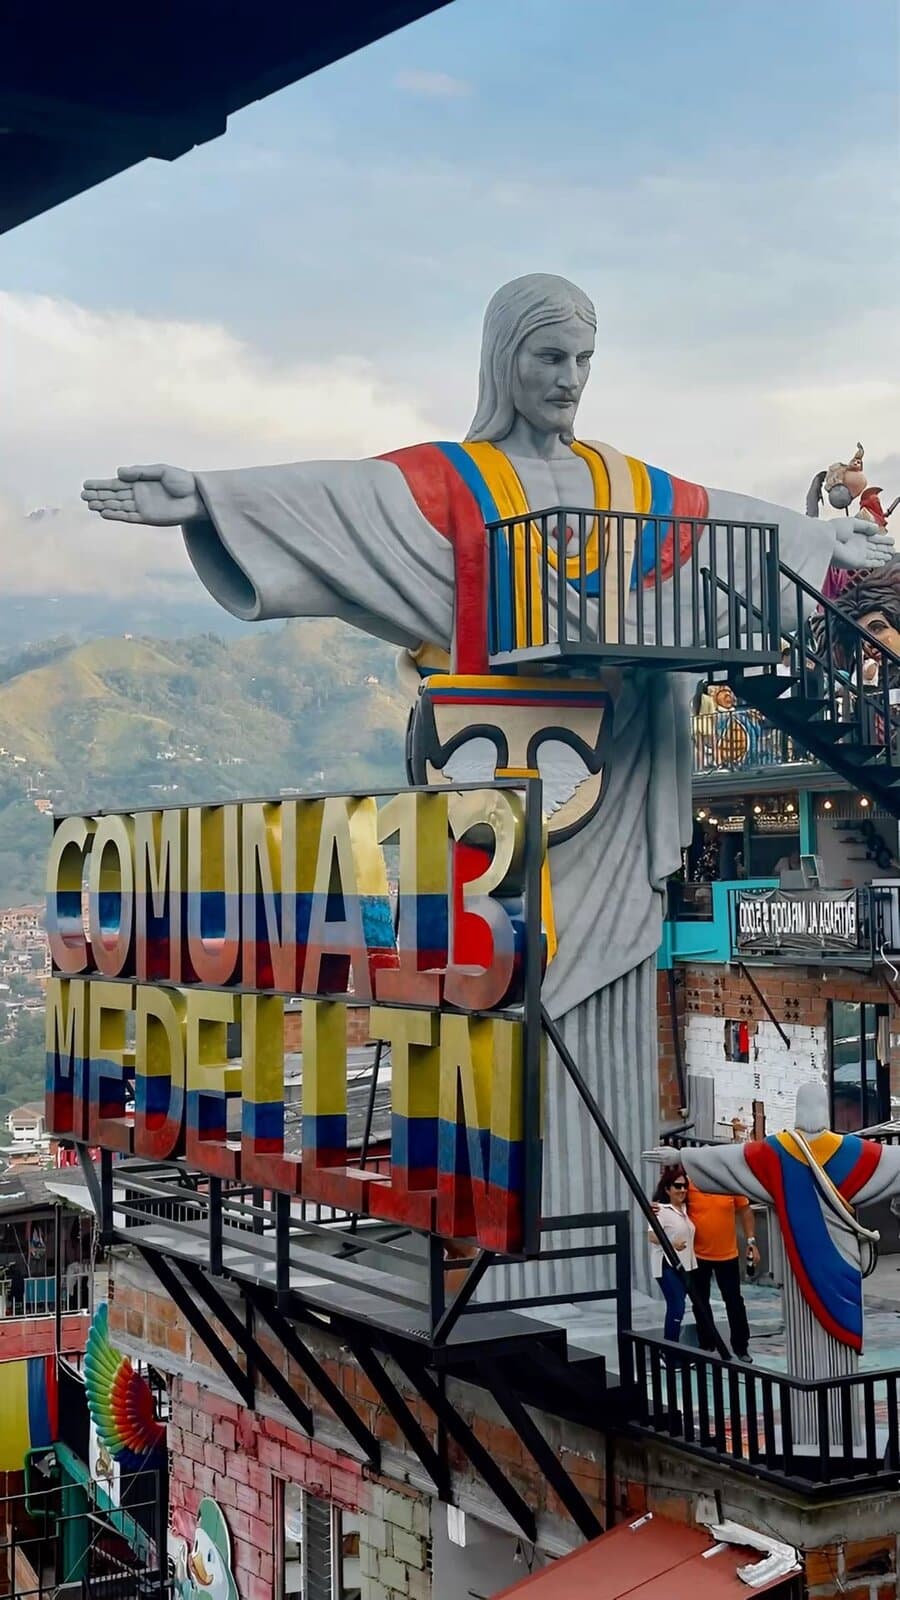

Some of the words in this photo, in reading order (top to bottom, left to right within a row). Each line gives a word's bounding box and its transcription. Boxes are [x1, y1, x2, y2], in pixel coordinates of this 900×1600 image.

[46, 797, 376, 1001] COMUNA
[377, 788, 519, 1010] 13
[46, 979, 524, 1253] MEDELLIN
